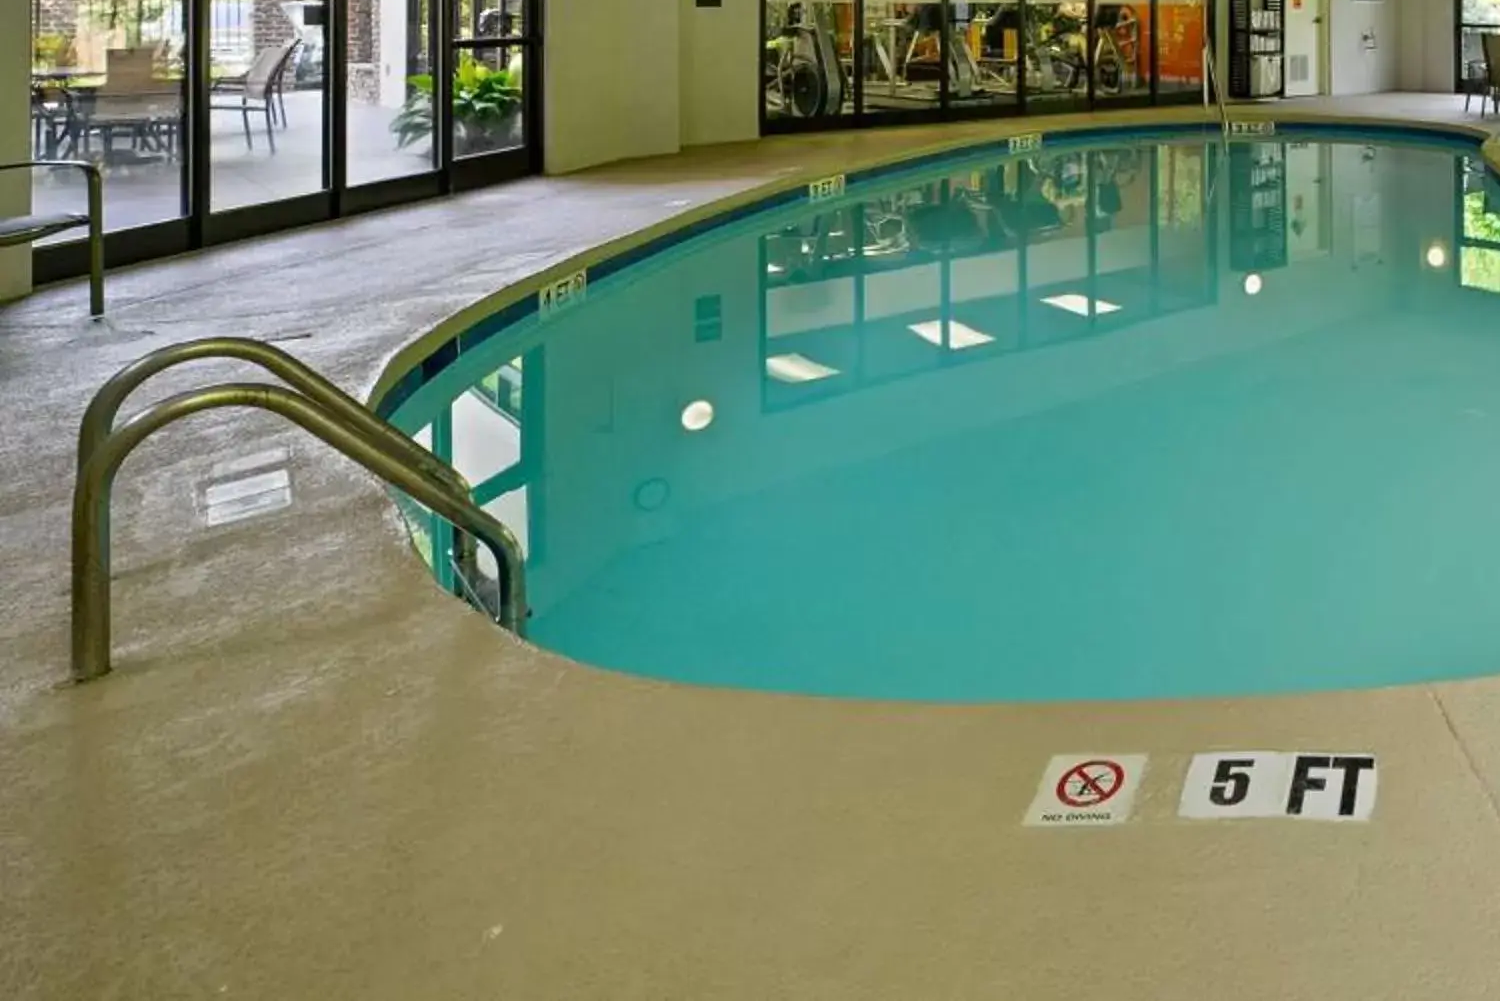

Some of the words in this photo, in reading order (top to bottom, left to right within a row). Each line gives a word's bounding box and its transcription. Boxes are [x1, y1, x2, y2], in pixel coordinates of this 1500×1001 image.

[1208, 759, 1255, 805] 5
[1286, 756, 1375, 816] FT
[1041, 814, 1063, 822] NO
[1066, 812, 1112, 822] DIVING
